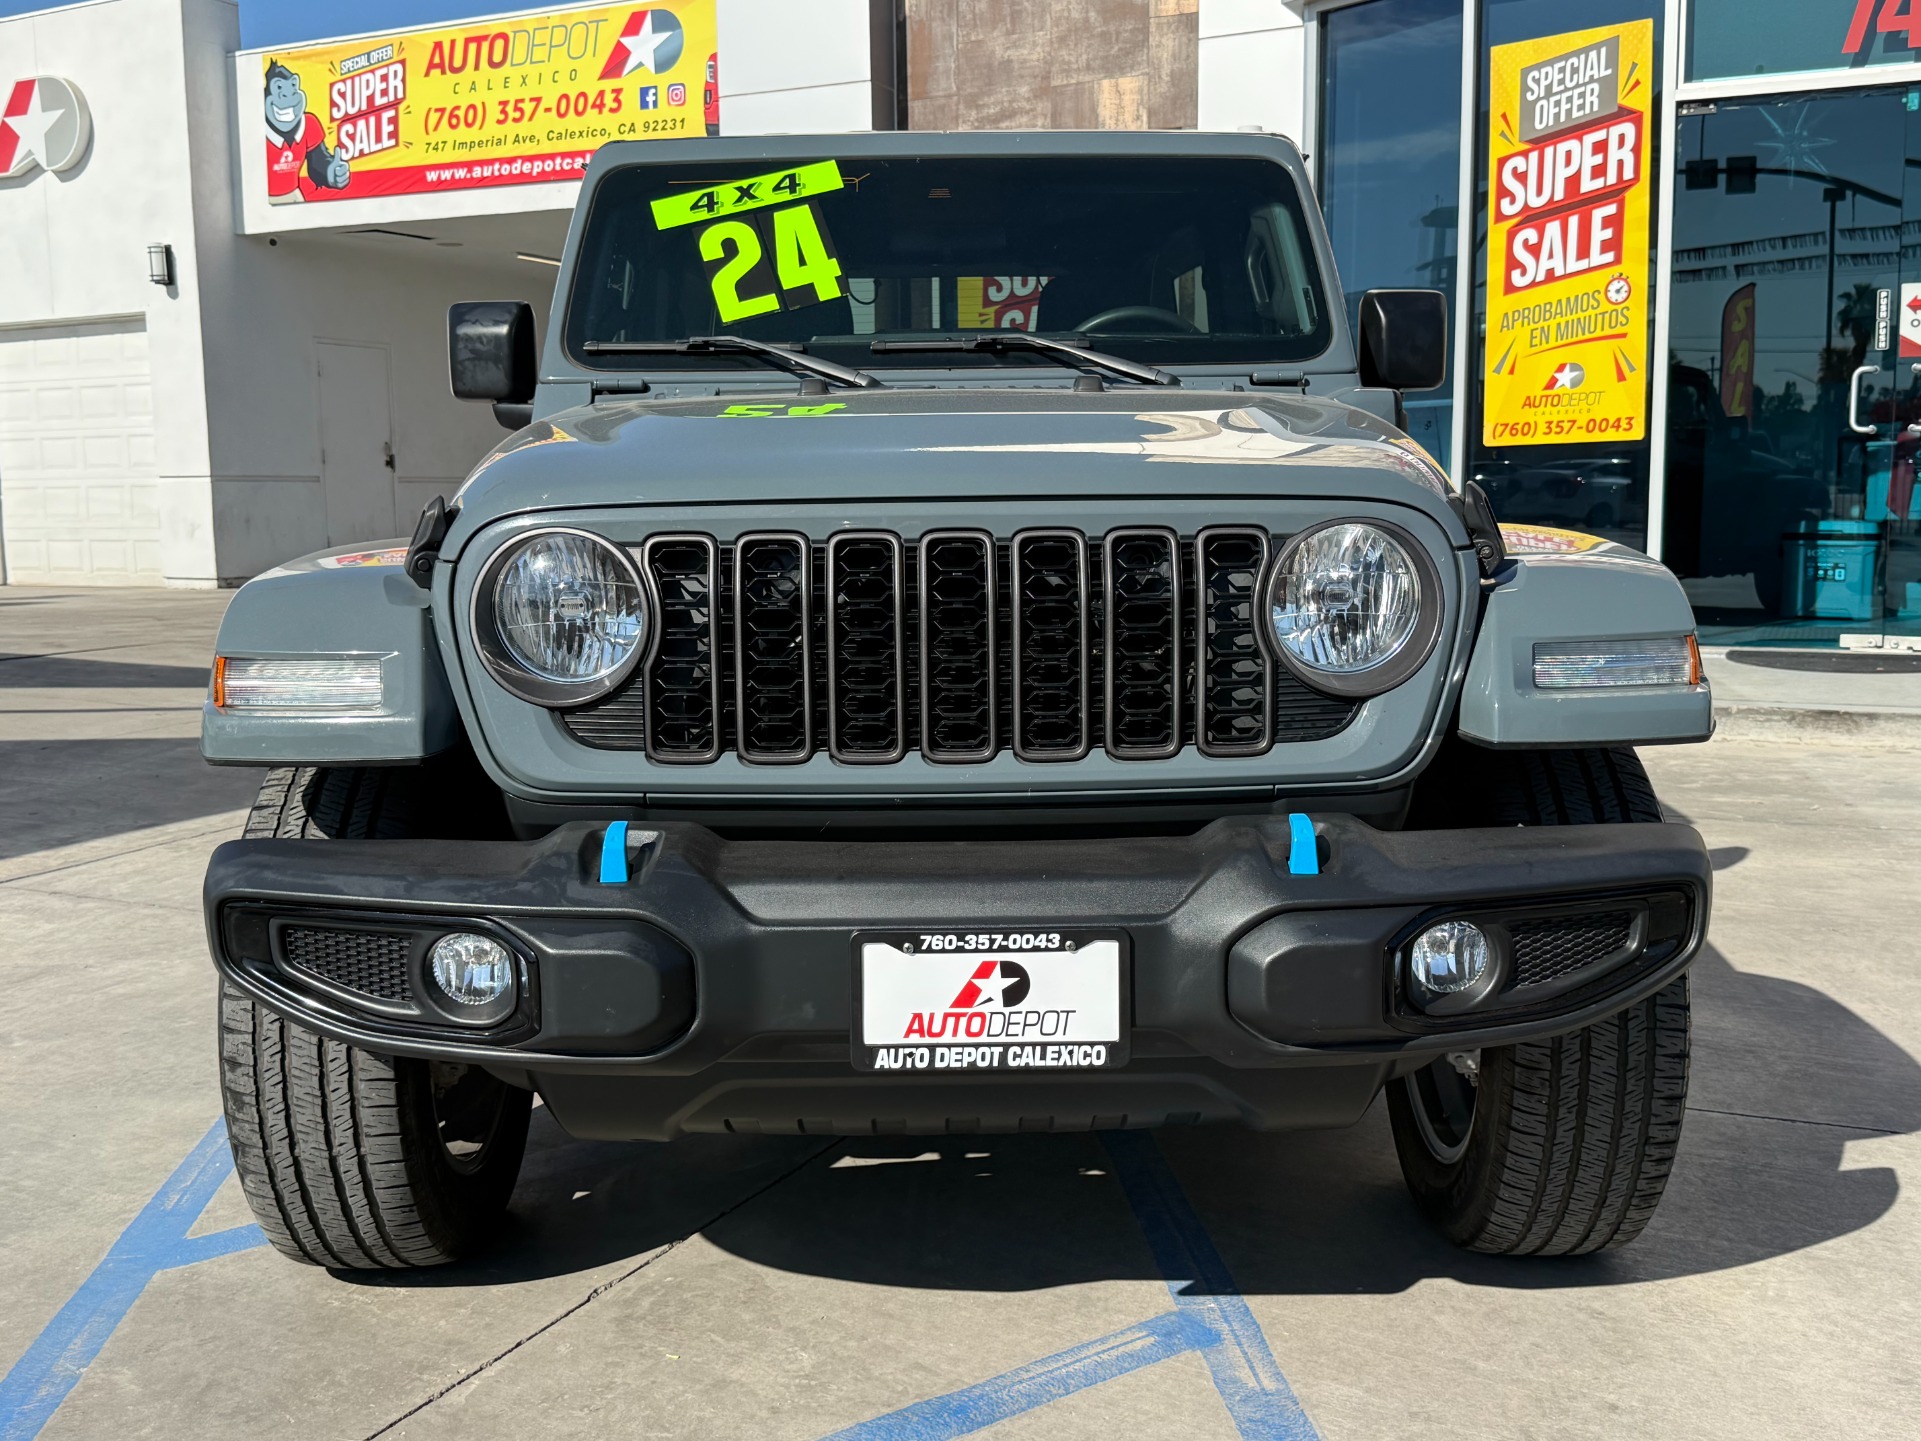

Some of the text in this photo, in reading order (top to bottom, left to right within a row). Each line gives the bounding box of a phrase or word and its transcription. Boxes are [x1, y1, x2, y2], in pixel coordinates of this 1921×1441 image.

[340, 45, 393, 74] SPECIAL OFFER
[423, 19, 608, 78] AUTODEPOT
[331, 62, 404, 119] SUPER
[453, 69, 577, 94] CALEXICO
[1526, 46, 1612, 101] SPECIAL
[424, 88, 624, 135] (760) 357-0043
[1534, 82, 1600, 130] OFFER
[340, 109, 396, 161] SALE
[425, 117, 686, 154] 747 Imperial Ave, Calexico, CA 92231
[1500, 121, 1636, 216] SUPER
[699, 204, 842, 323] 24
[1510, 202, 1618, 288] SALE
[1499, 289, 1602, 333] APROBAMOS
[1879, 291, 1888, 318] PUSH
[1529, 306, 1630, 348] EN MINUTOS
[1878, 320, 1887, 348] PUSH
[1521, 390, 1605, 410] AUTODEPOT
[1492, 416, 1635, 440] (760) 357-0043
[919, 933, 1061, 951] 760-357-0043
[903, 1009, 1076, 1039] AUTODEPOT
[874, 1045, 1107, 1070] AUTO DEPOT CALEXICO
